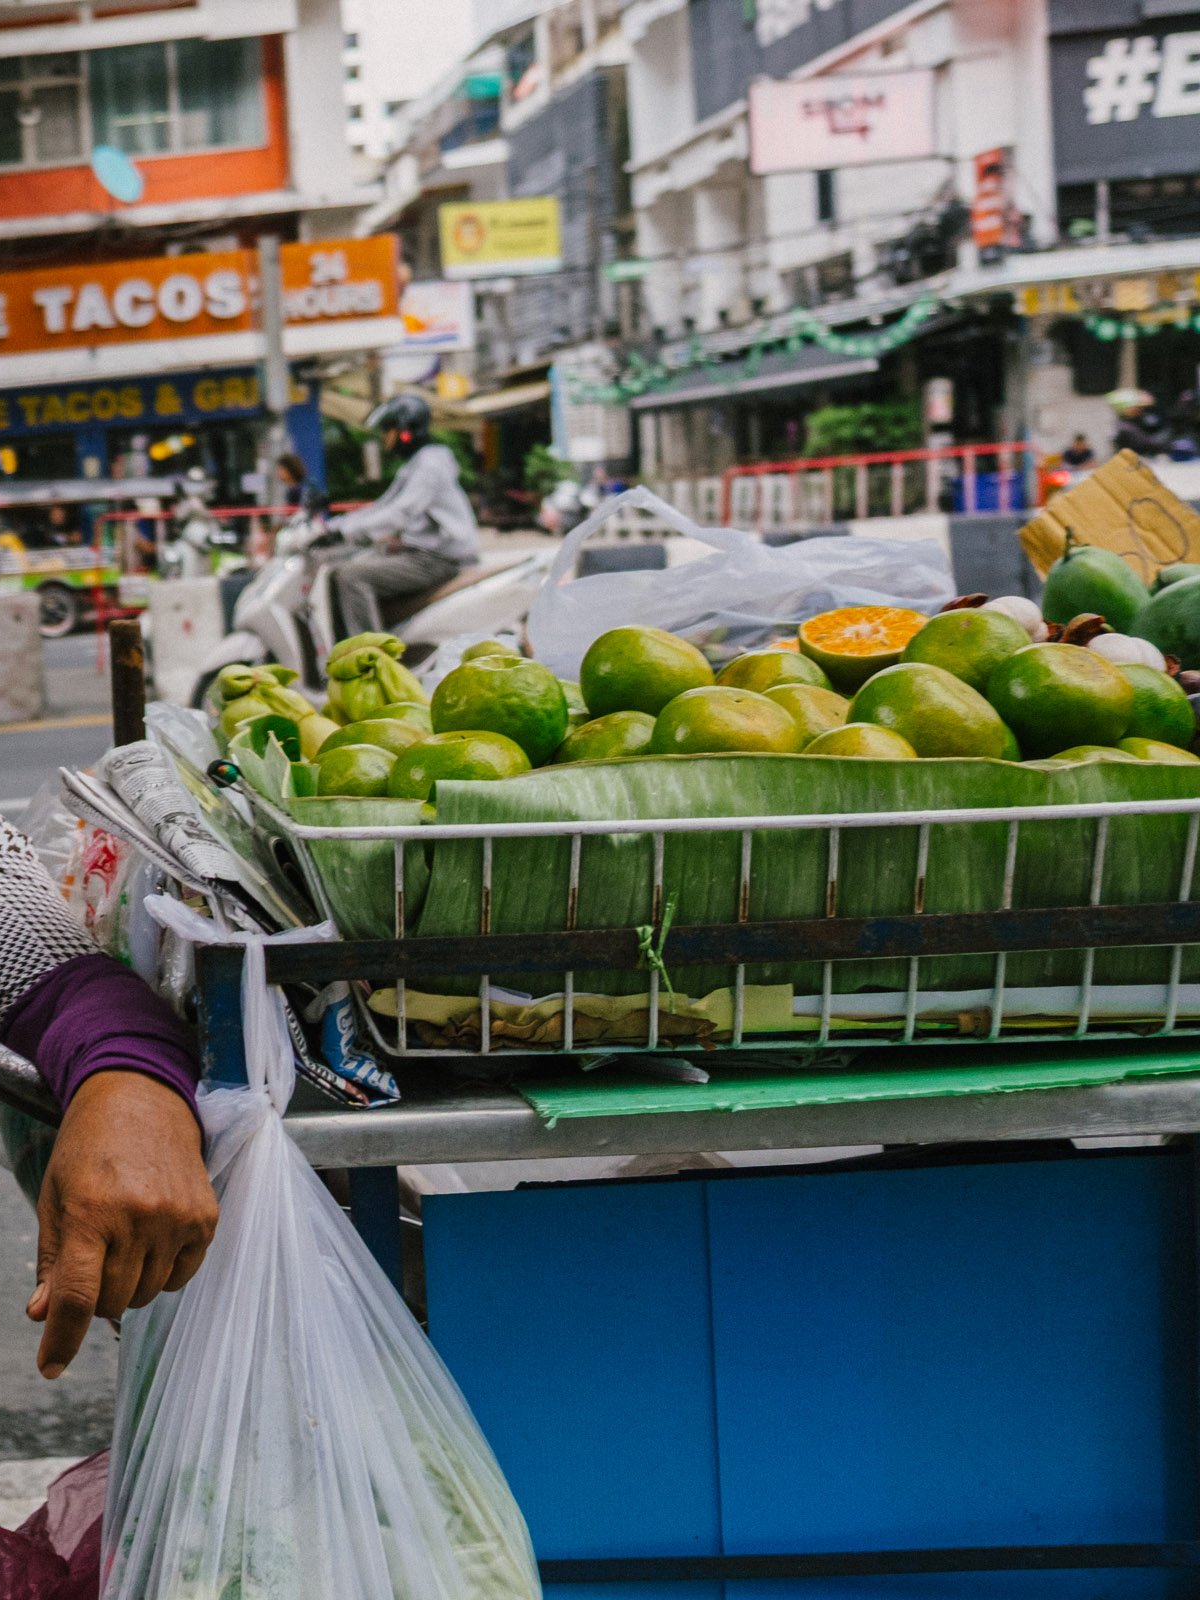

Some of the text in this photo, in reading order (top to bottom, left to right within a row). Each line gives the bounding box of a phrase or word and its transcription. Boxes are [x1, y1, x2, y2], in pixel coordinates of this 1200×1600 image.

[33, 269, 247, 333] TACOS
[20, 387, 142, 426] TACOS
[154, 383, 182, 415] &
